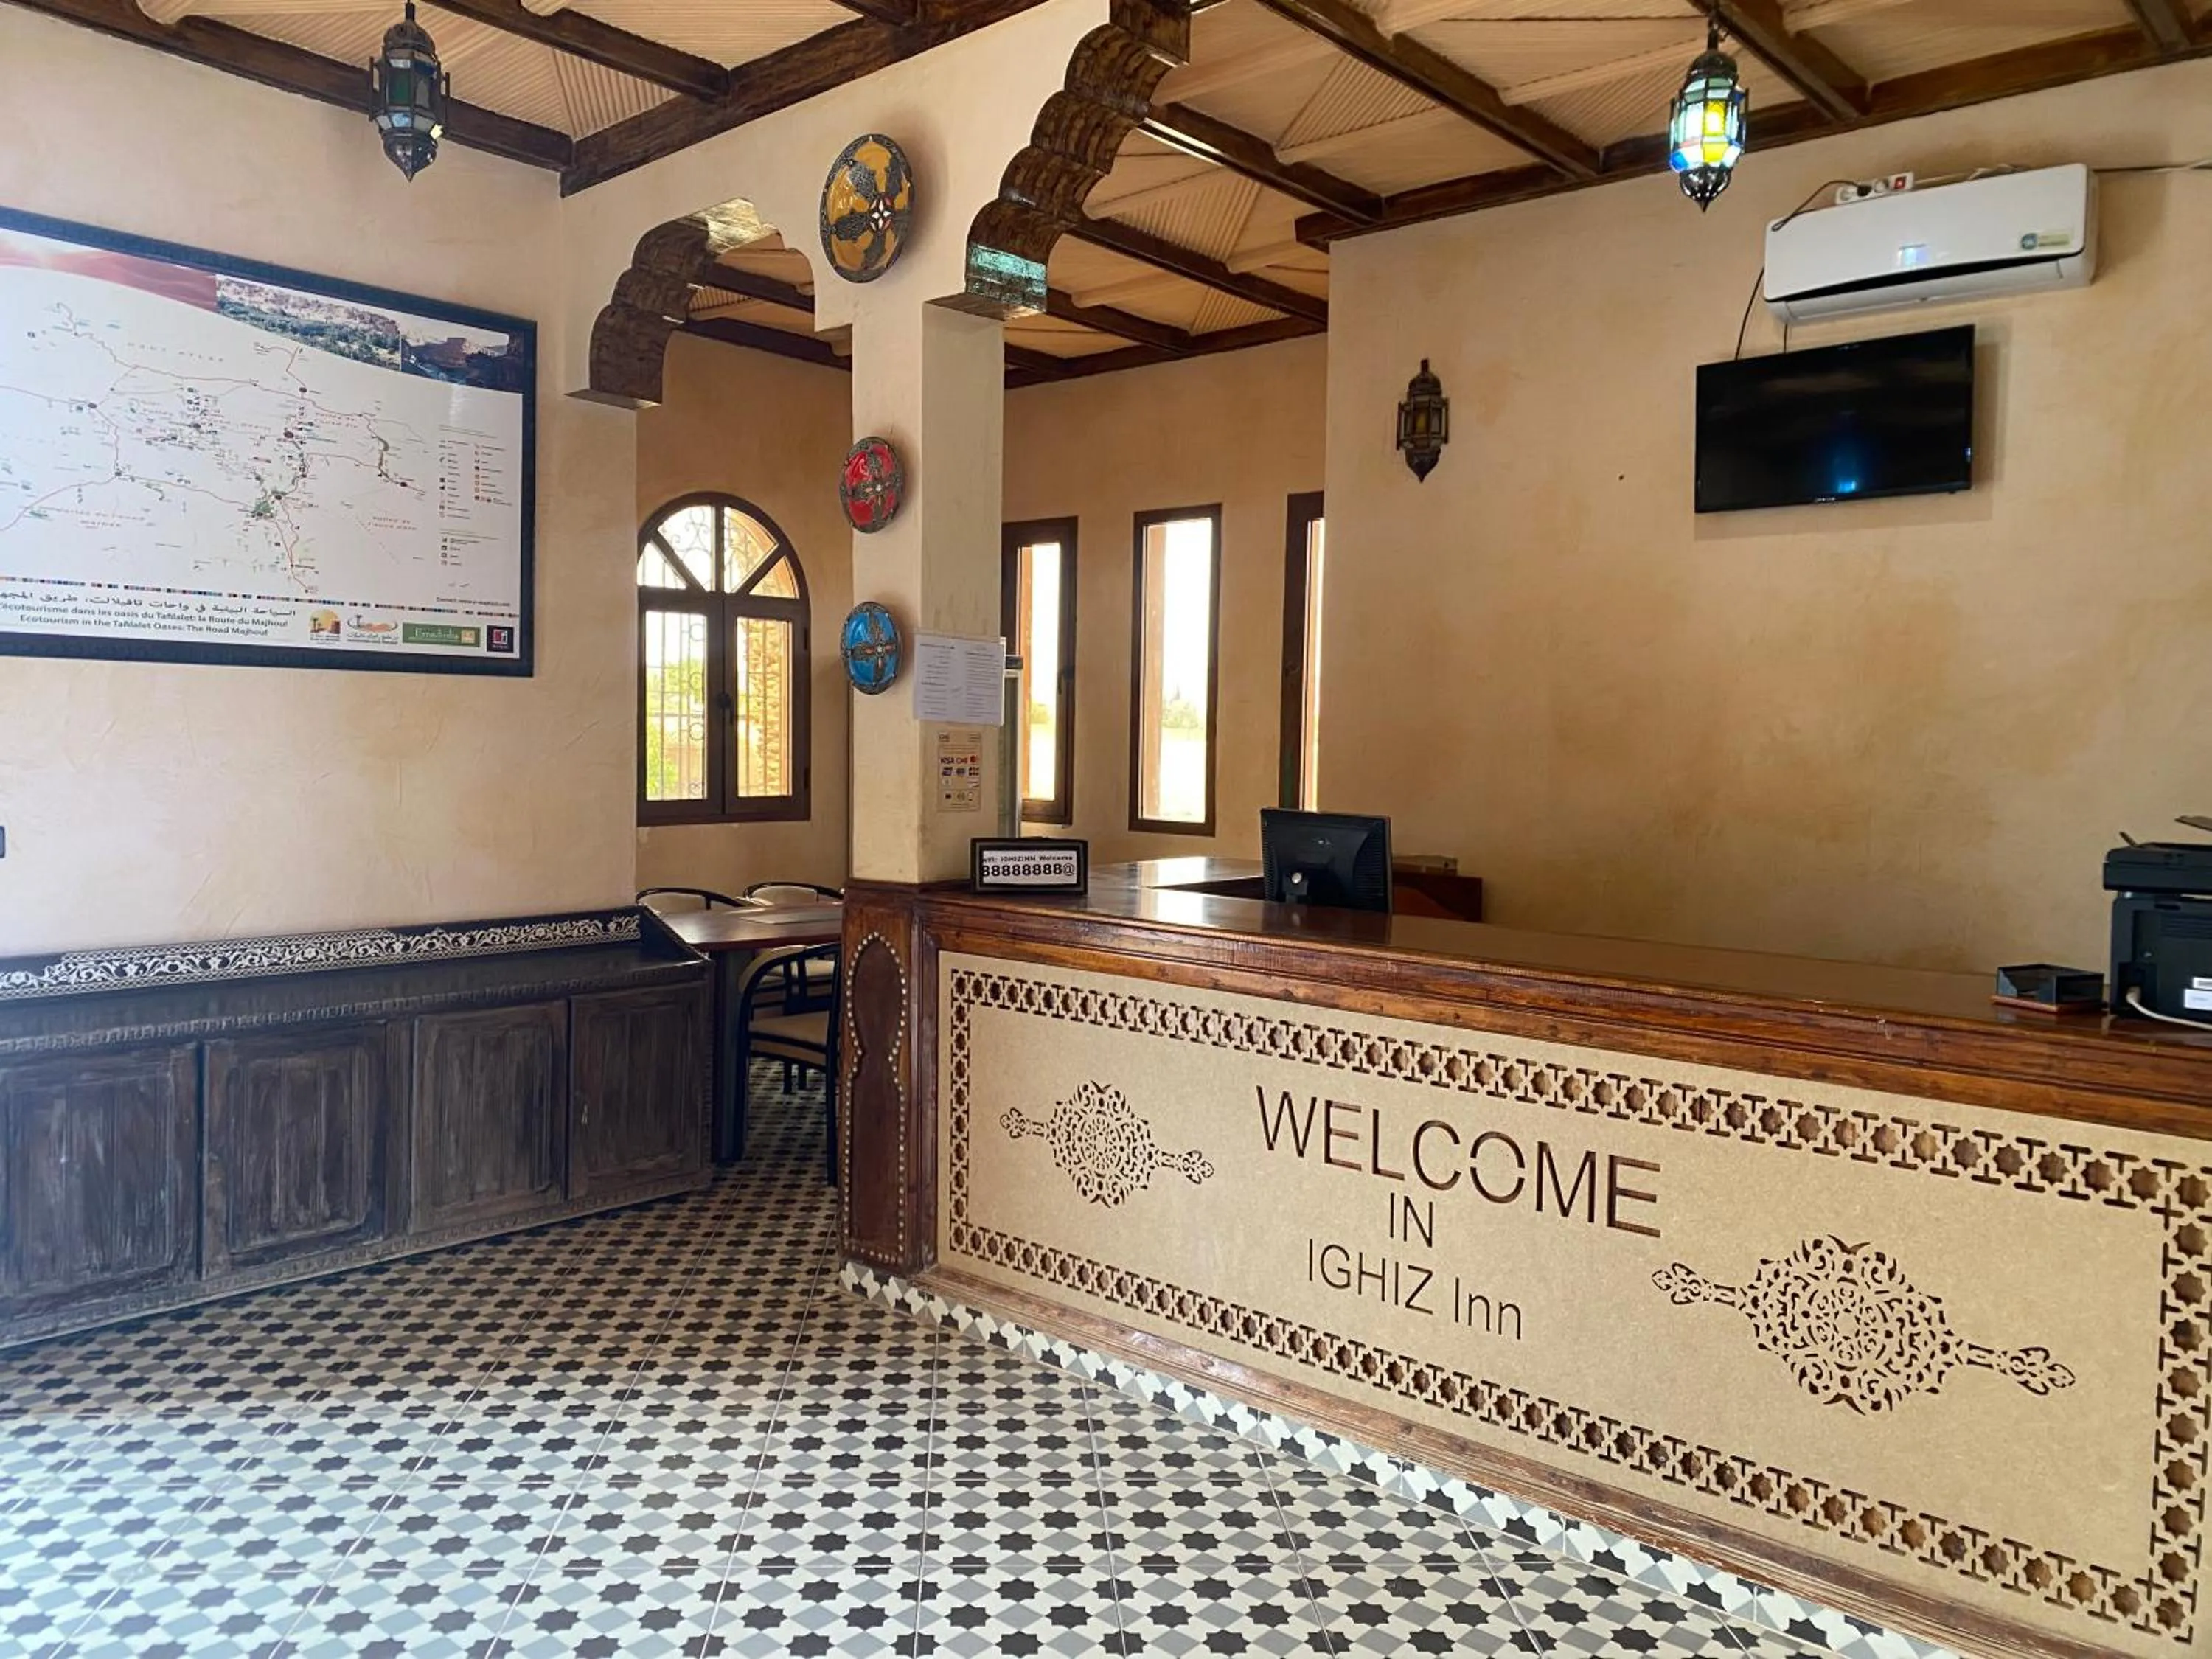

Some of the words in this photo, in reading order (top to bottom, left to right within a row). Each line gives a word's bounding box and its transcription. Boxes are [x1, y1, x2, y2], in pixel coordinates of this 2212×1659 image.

[20, 614, 79, 625] Ecotourism
[206, 625, 229, 633] Road
[70, 606, 95, 615] dans
[98, 608, 111, 616] les
[209, 615, 235, 624] Route
[1256, 1085, 1661, 1238] WELCOME
[1389, 1192, 1433, 1248] IN
[1308, 1238, 1434, 1315] IGHIZ
[1454, 1277, 1522, 1340] Inn
